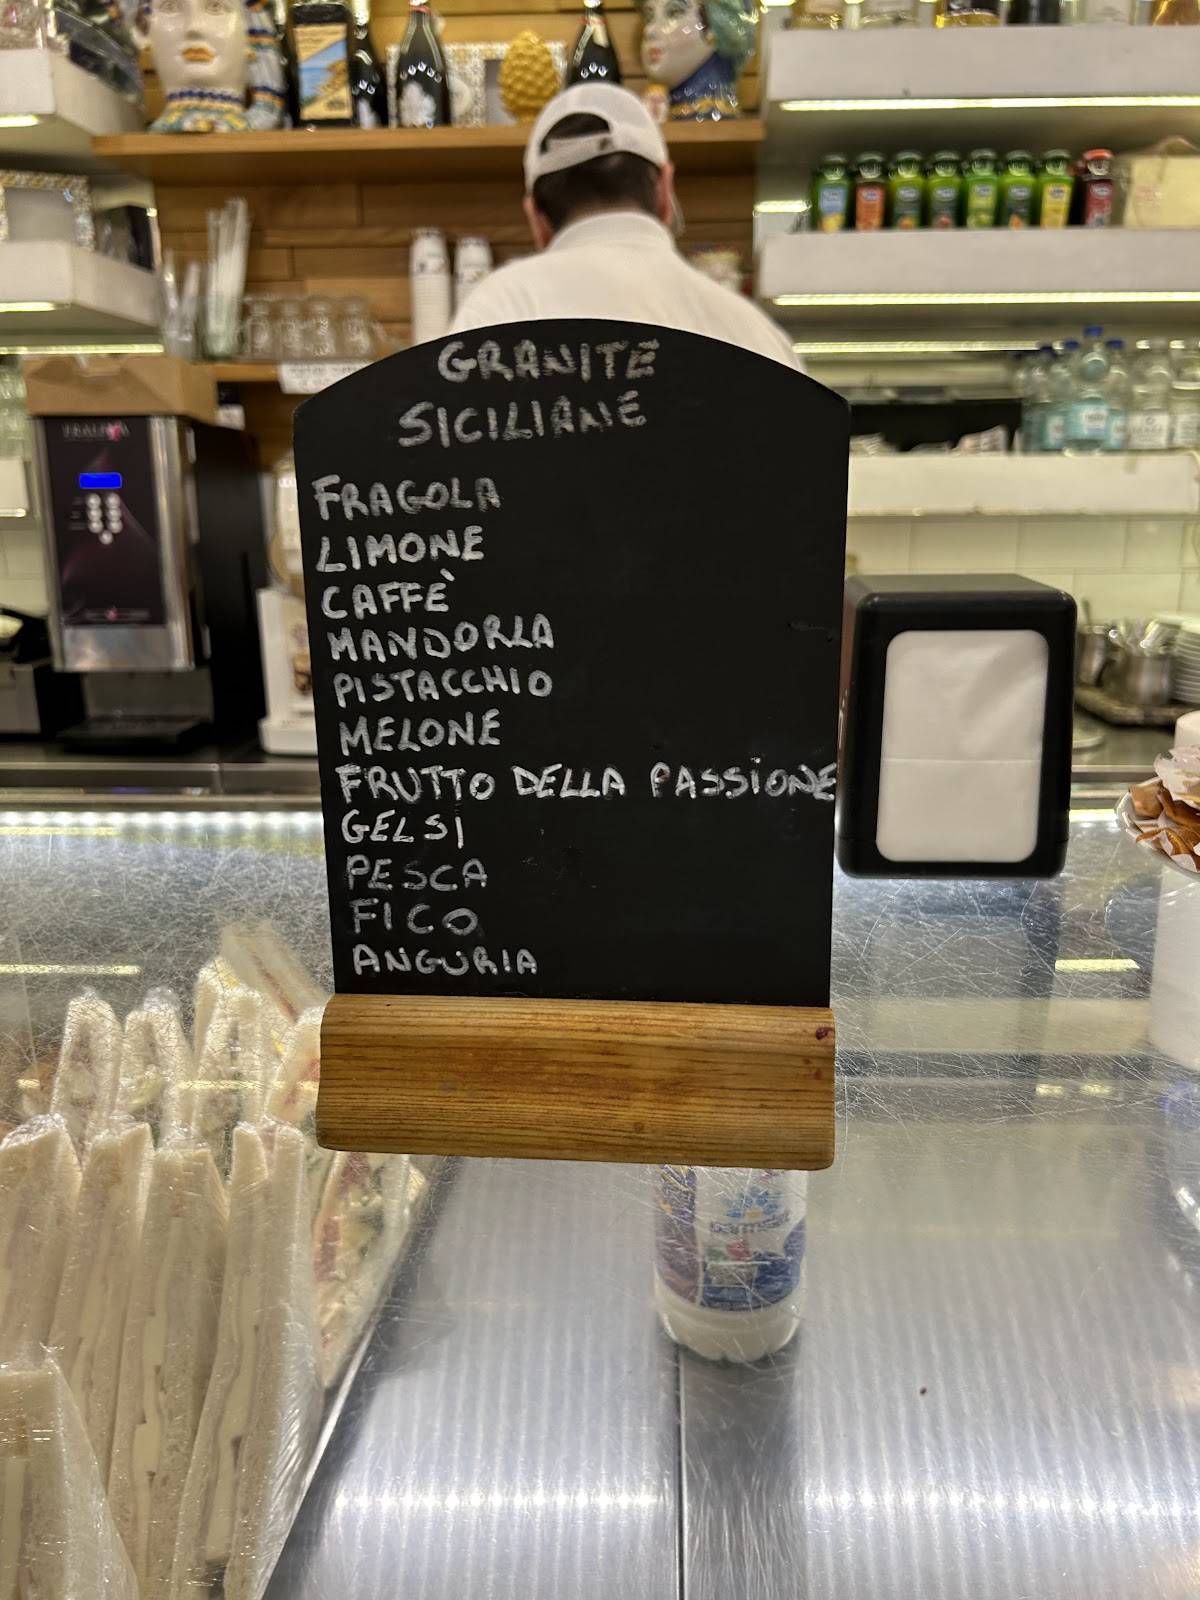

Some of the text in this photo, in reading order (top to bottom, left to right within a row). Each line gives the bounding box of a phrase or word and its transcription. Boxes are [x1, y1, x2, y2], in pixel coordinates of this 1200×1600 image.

[437, 338, 660, 383] GRANITE
[399, 389, 647, 447] SICILIANE
[311, 474, 501, 521] FRAGOLA
[316, 525, 485, 573] LIMONE
[320, 568, 455, 620] CAFFÈ
[326, 613, 555, 662] MANDORLA
[333, 665, 553, 708] PISTACCHIO
[339, 708, 501, 756] MELONE
[335, 763, 496, 803] FRUTTO
[511, 763, 626, 799] DELLA
[341, 808, 465, 849] GELSI
[346, 855, 488, 891] PESCA
[352, 897, 479, 936] FICO
[352, 943, 537, 976] ANGURIA
